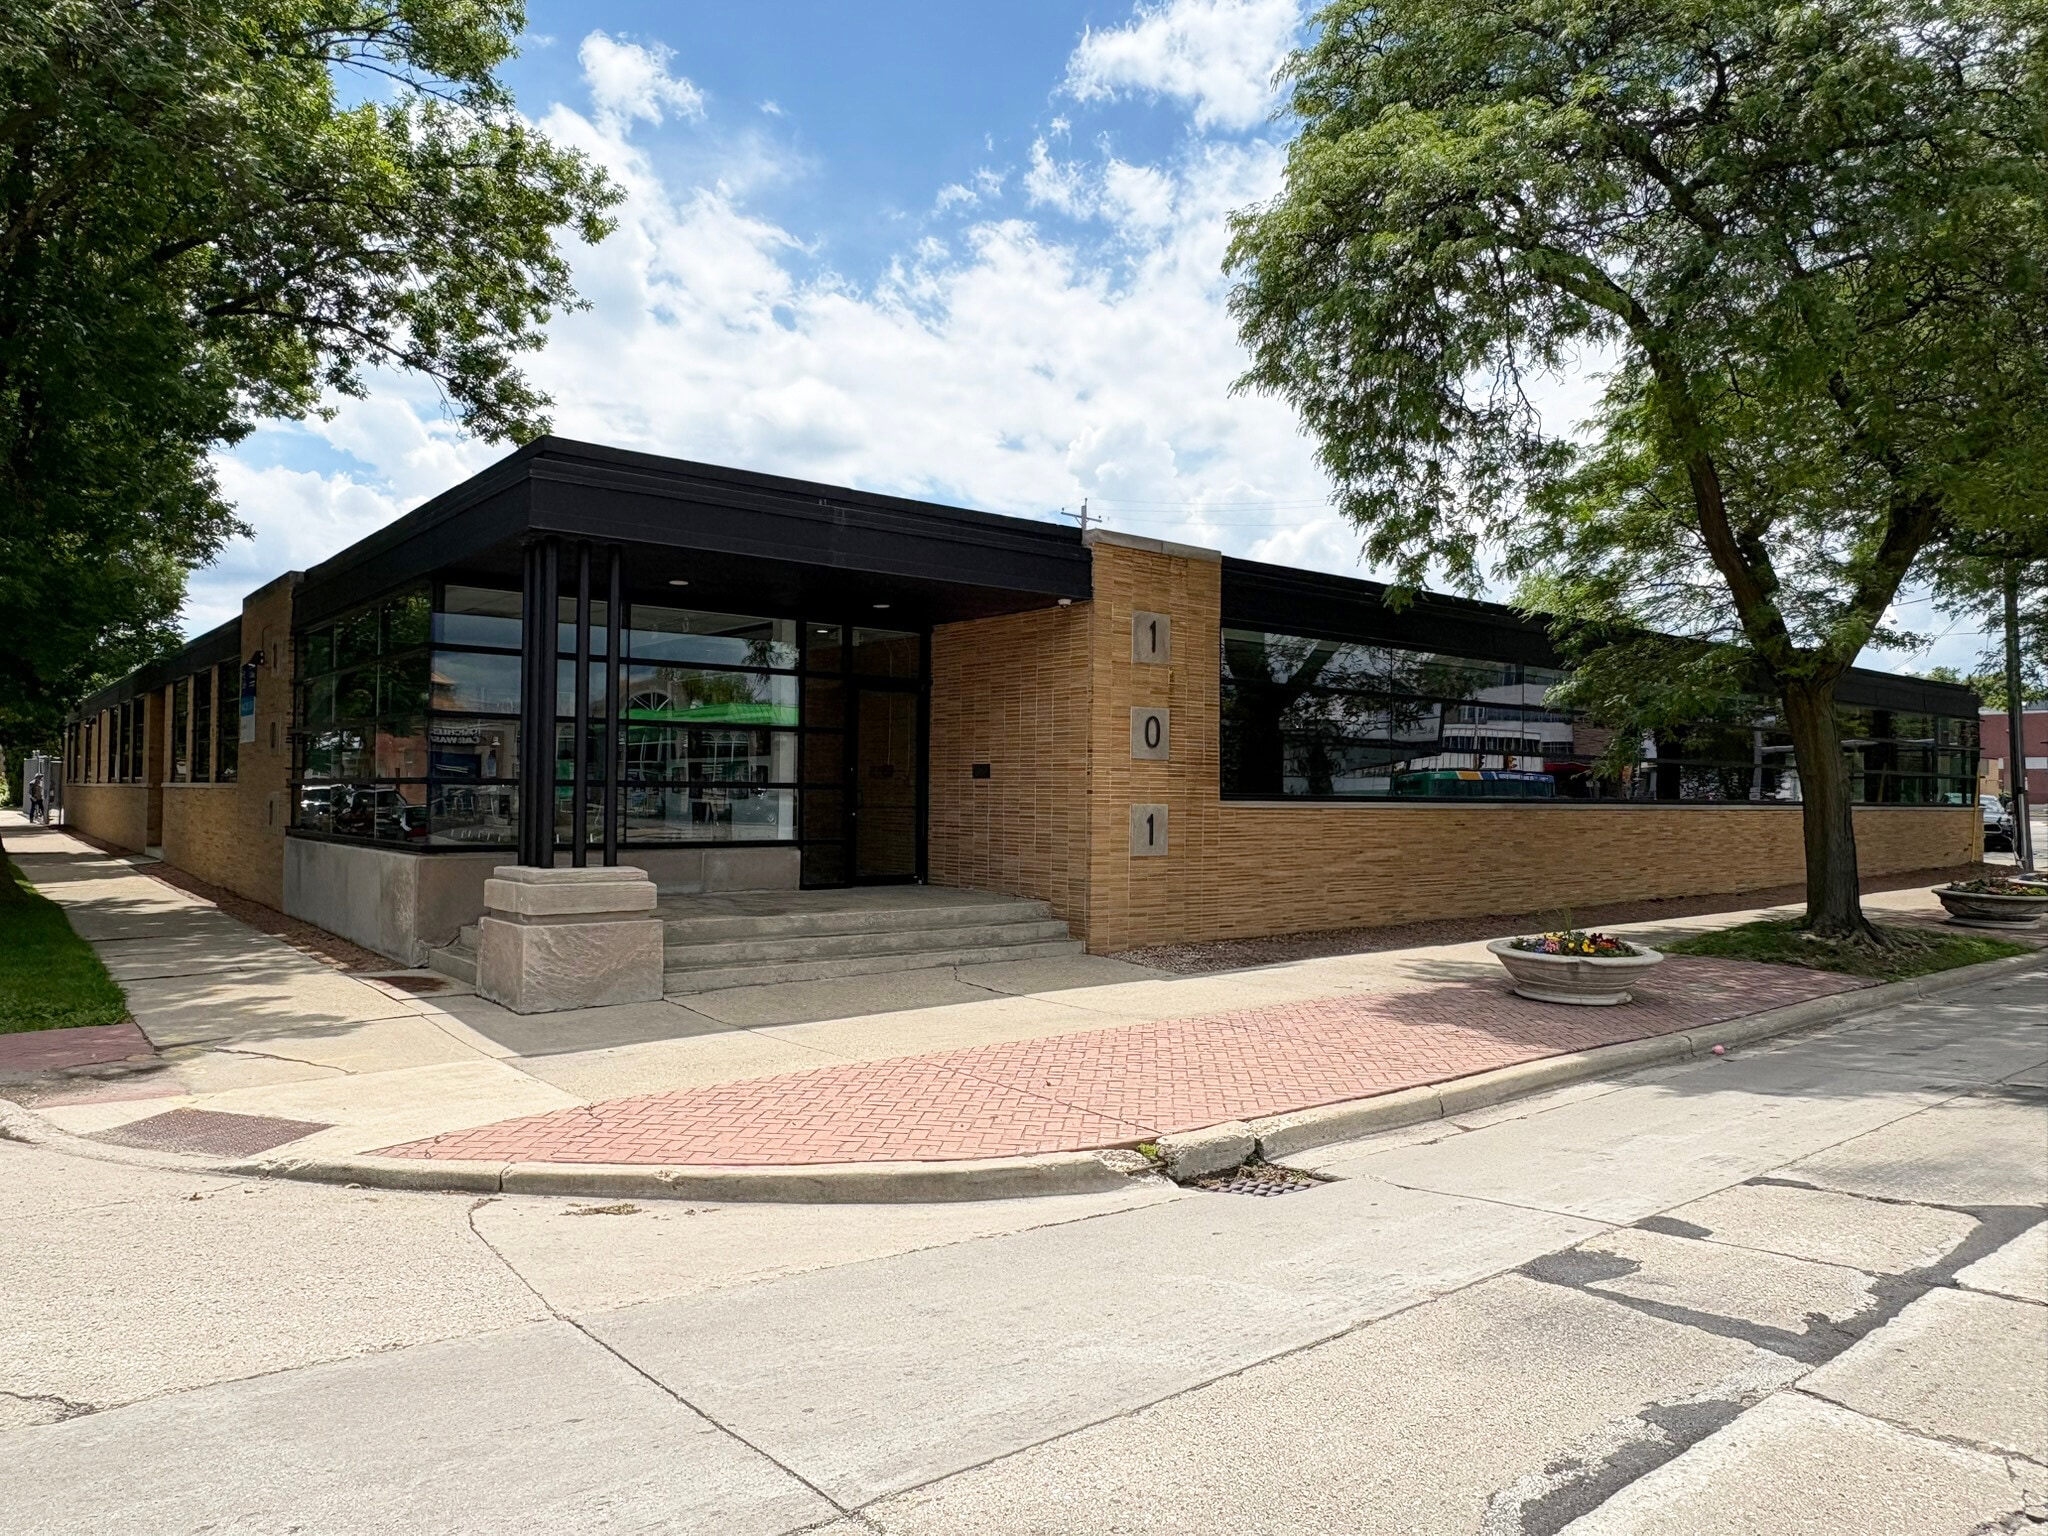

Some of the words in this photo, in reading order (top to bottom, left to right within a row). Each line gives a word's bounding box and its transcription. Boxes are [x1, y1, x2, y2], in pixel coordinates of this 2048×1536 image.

[1150, 620, 1156, 653] 1
[1145, 716, 1160, 749] 0
[1147, 814, 1153, 846] 1
